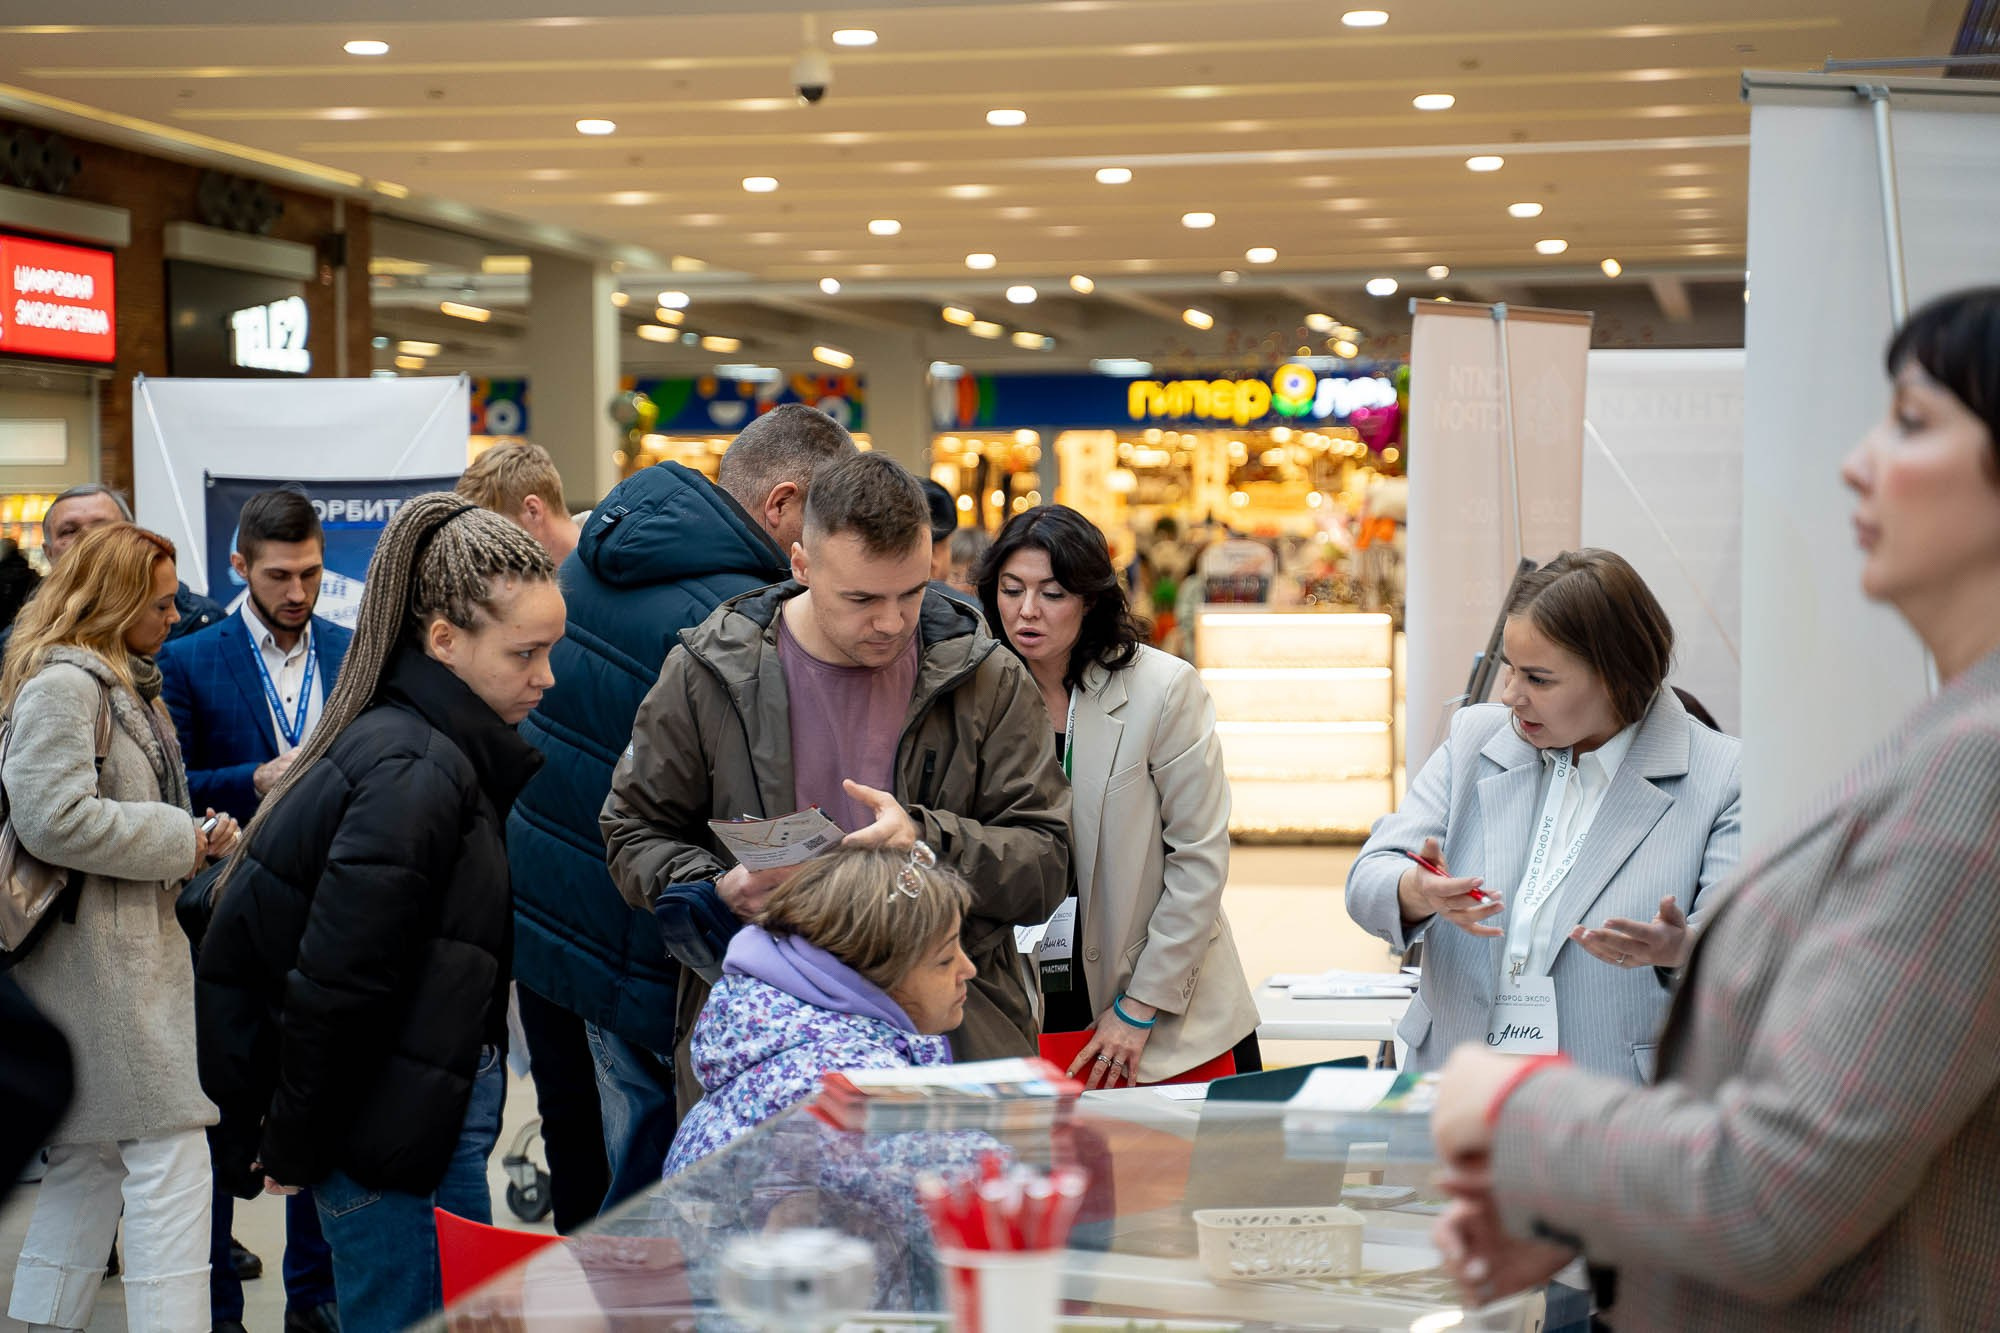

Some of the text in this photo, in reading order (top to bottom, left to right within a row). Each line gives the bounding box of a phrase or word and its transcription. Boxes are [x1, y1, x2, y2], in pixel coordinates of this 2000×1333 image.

[1556, 750, 1569, 778] КСПО
[1533, 815, 1554, 864] ЗАГОРОД
[1041, 963, 1069, 974] УЧАСТНИК
[1487, 1023, 1544, 1046] Анна
